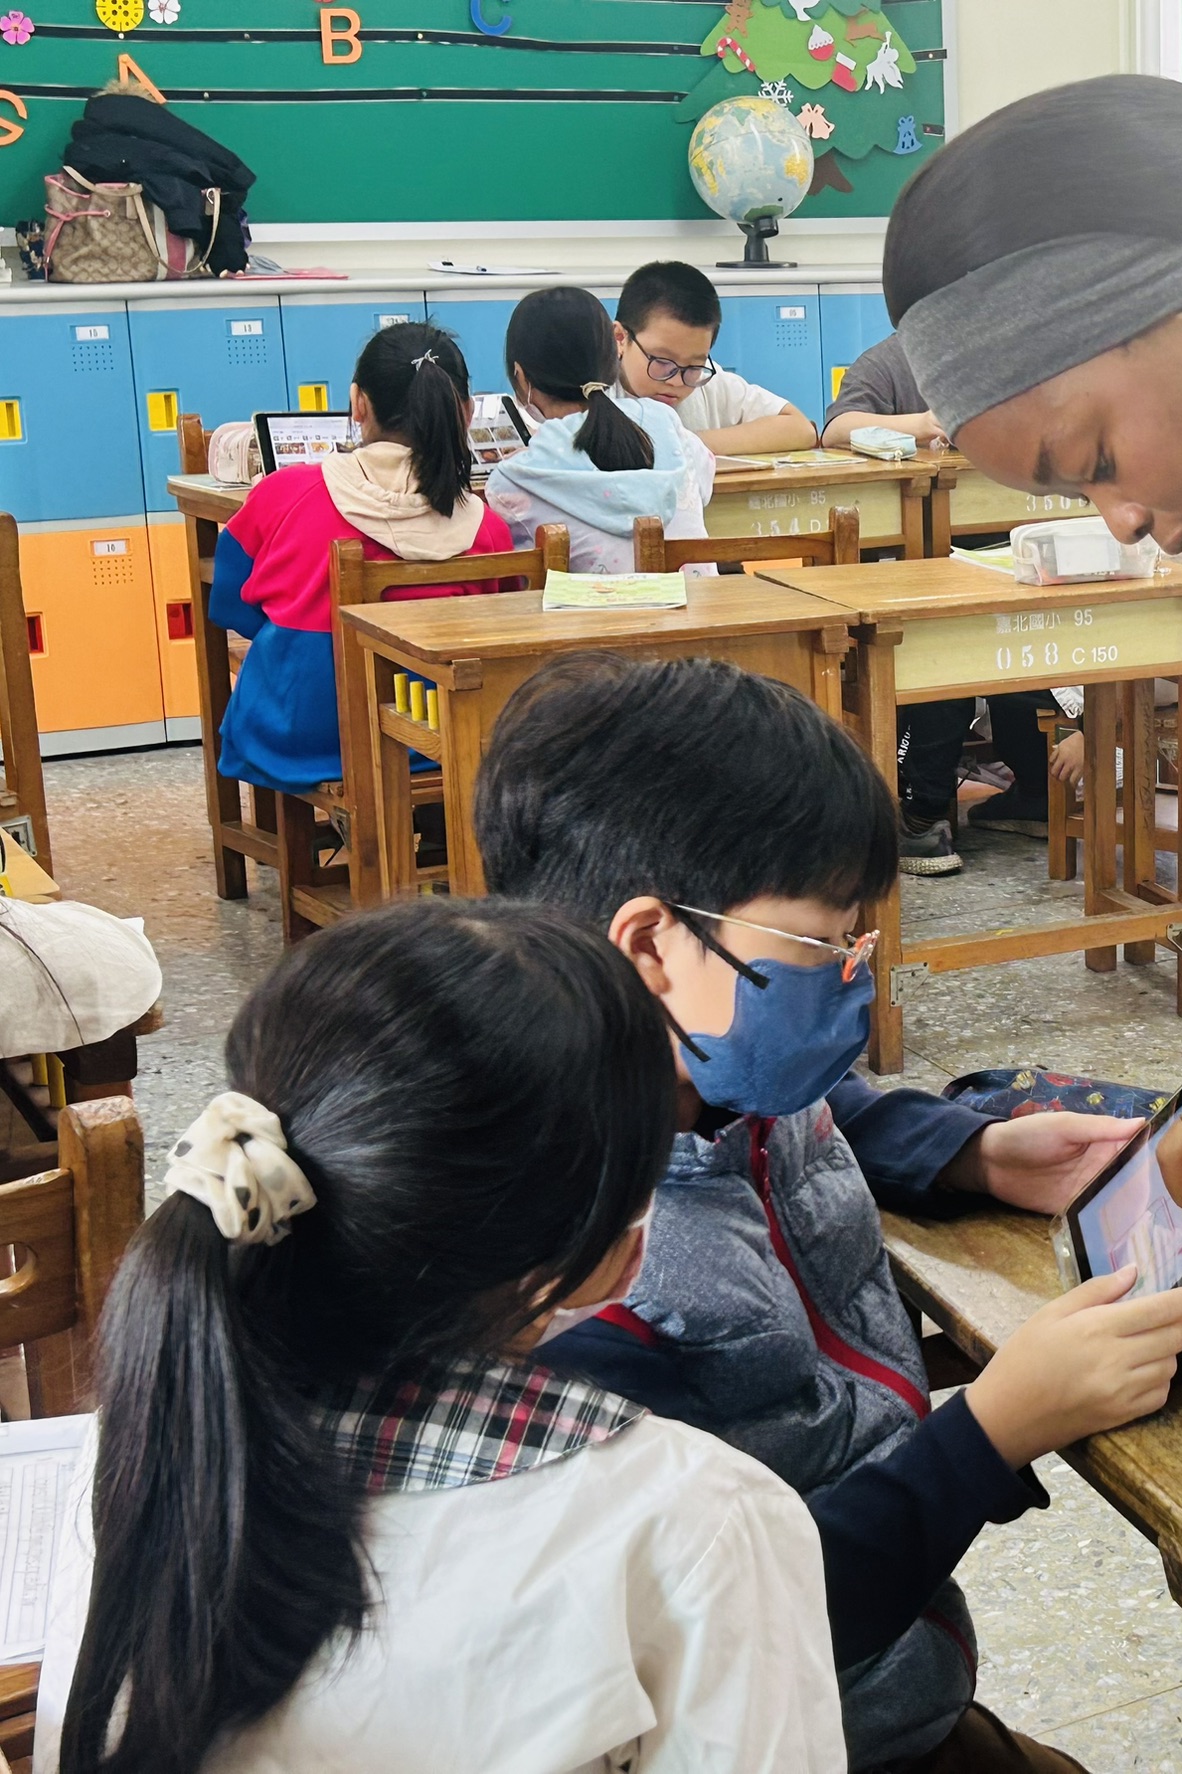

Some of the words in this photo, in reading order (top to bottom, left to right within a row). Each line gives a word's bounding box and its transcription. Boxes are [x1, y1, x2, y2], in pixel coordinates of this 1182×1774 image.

[320, 8, 362, 64] B
[470, 0, 512, 36] C
[118, 53, 167, 104] A
[1074, 608, 1093, 626] 95
